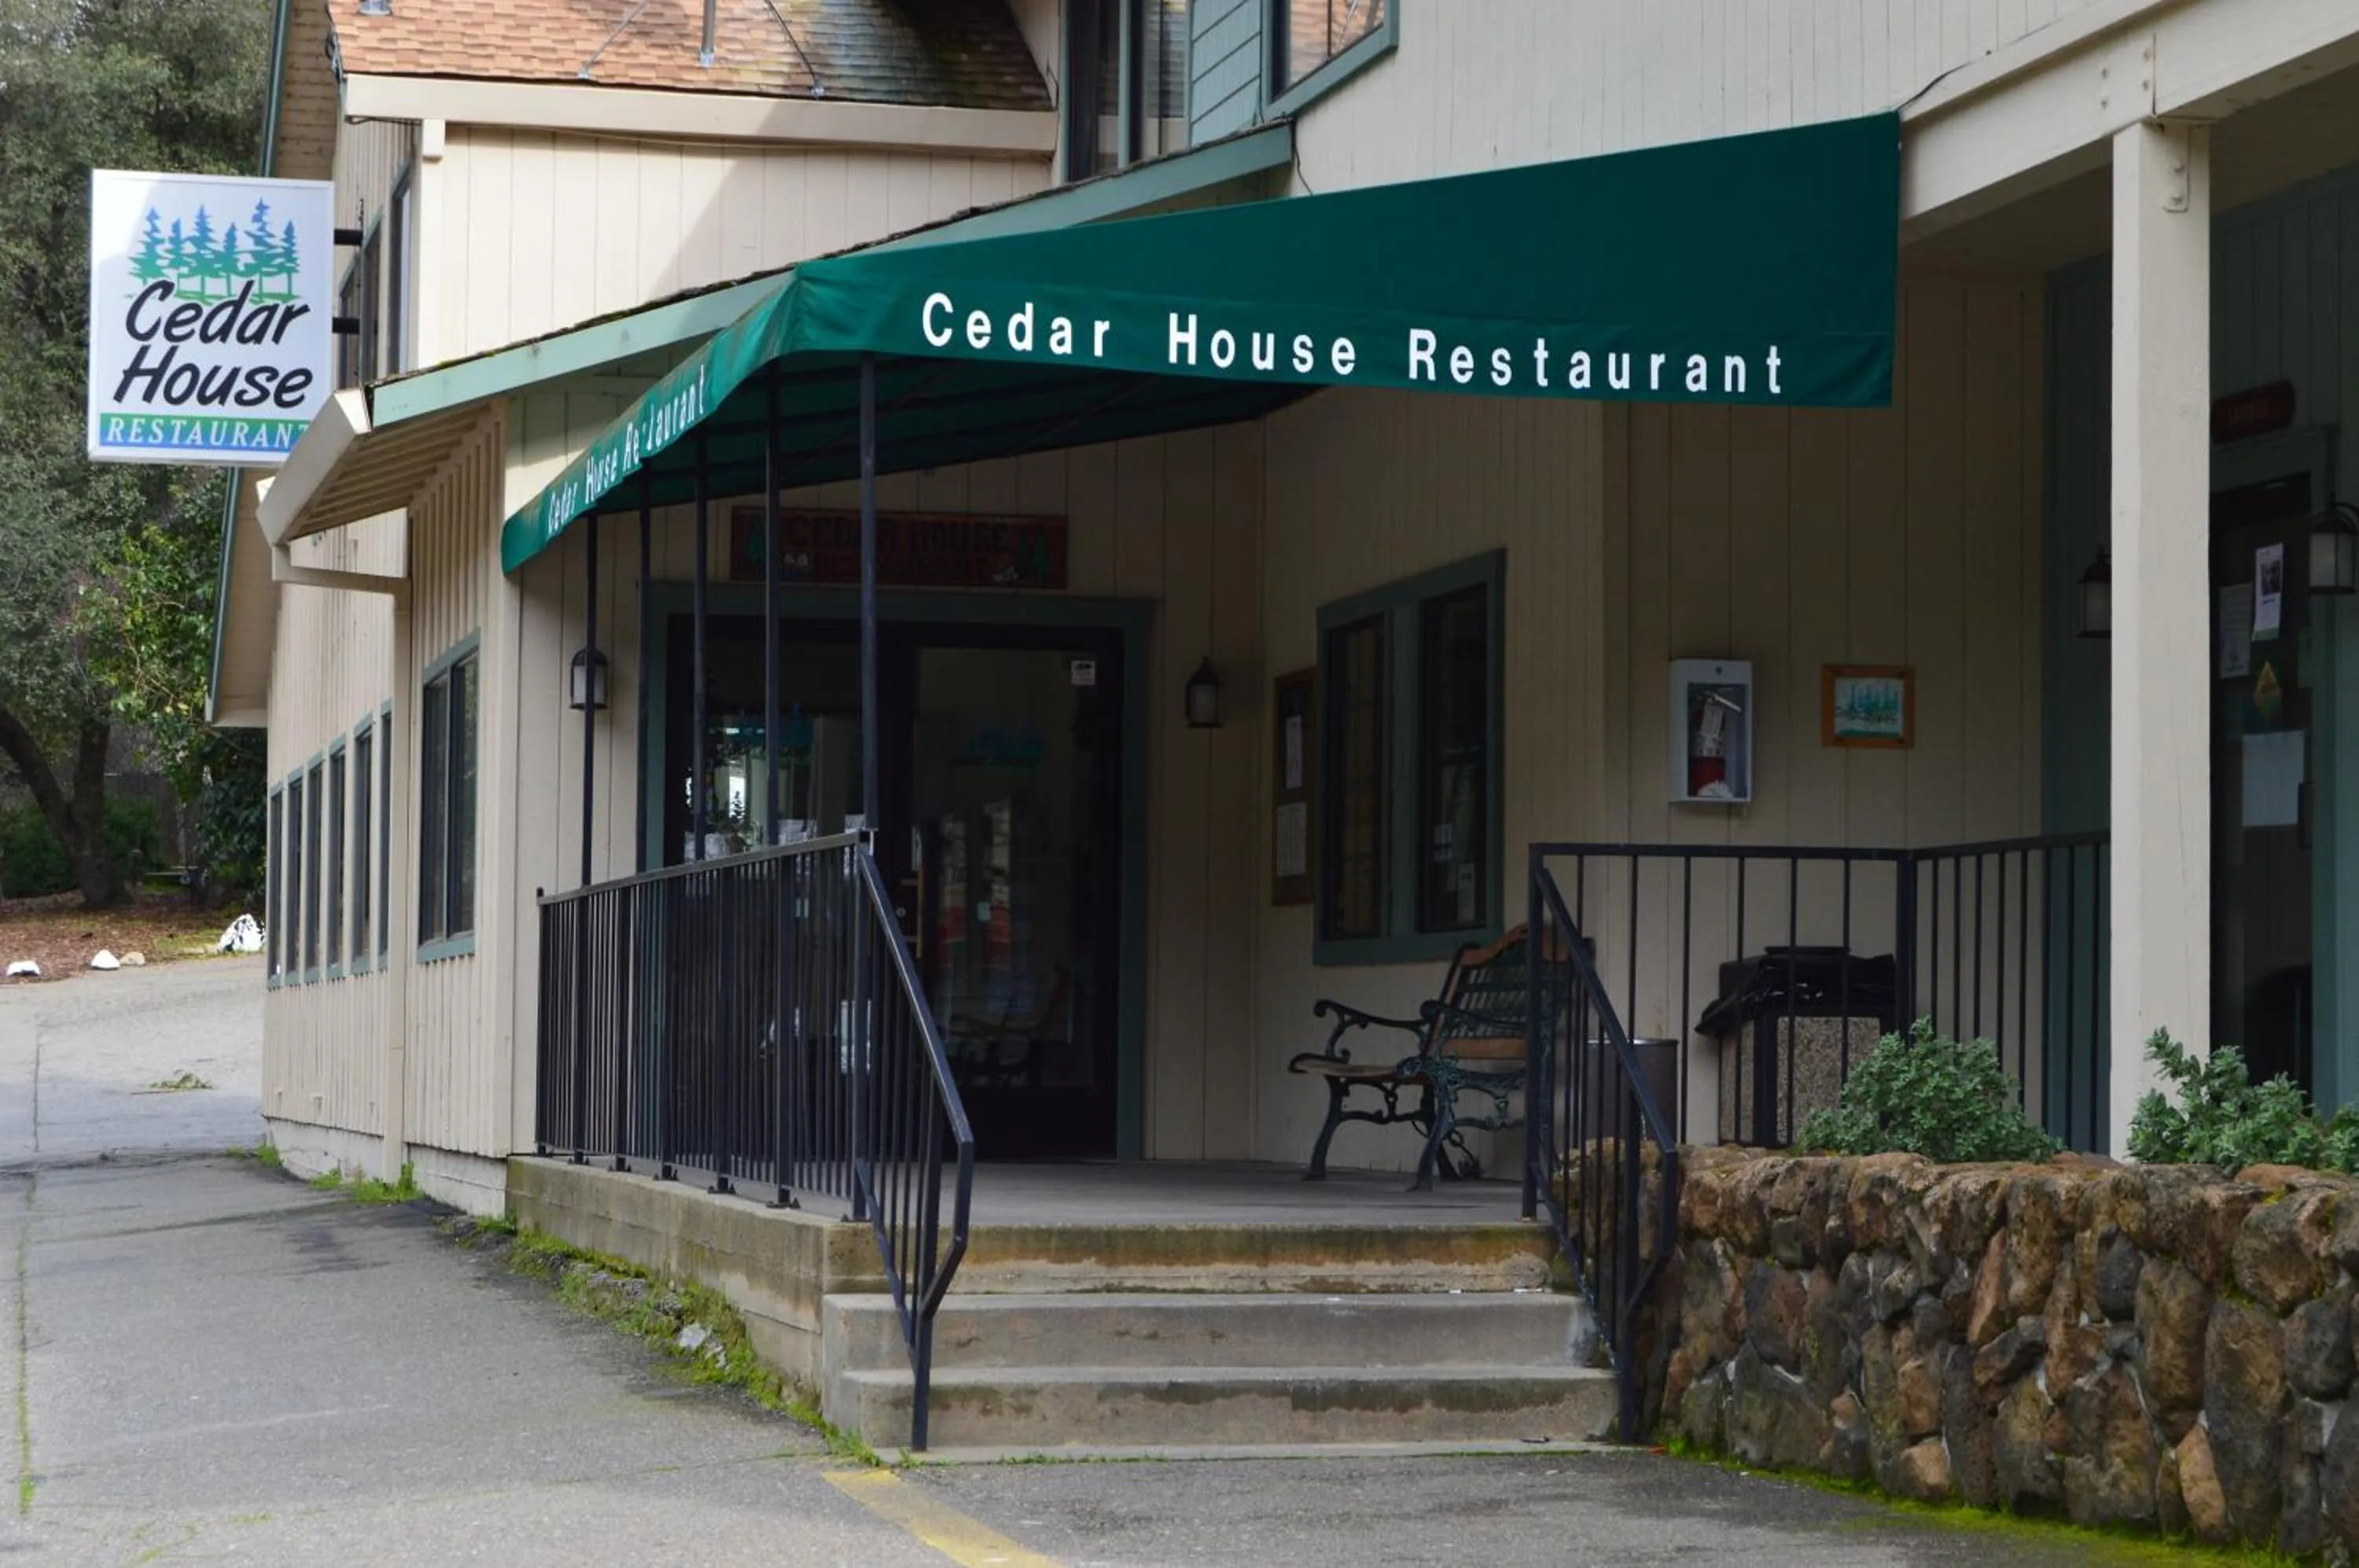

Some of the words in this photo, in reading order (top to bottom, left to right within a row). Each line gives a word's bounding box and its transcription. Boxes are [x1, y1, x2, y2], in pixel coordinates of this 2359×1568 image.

[126, 279, 311, 344] Cedar
[922, 292, 1111, 358] Cedar
[1168, 312, 1356, 376] House
[1408, 328, 1783, 394] Restaurant
[112, 345, 313, 409] House
[547, 480, 579, 536] Cedar
[584, 447, 618, 505] House
[623, 364, 705, 473] Retaurant
